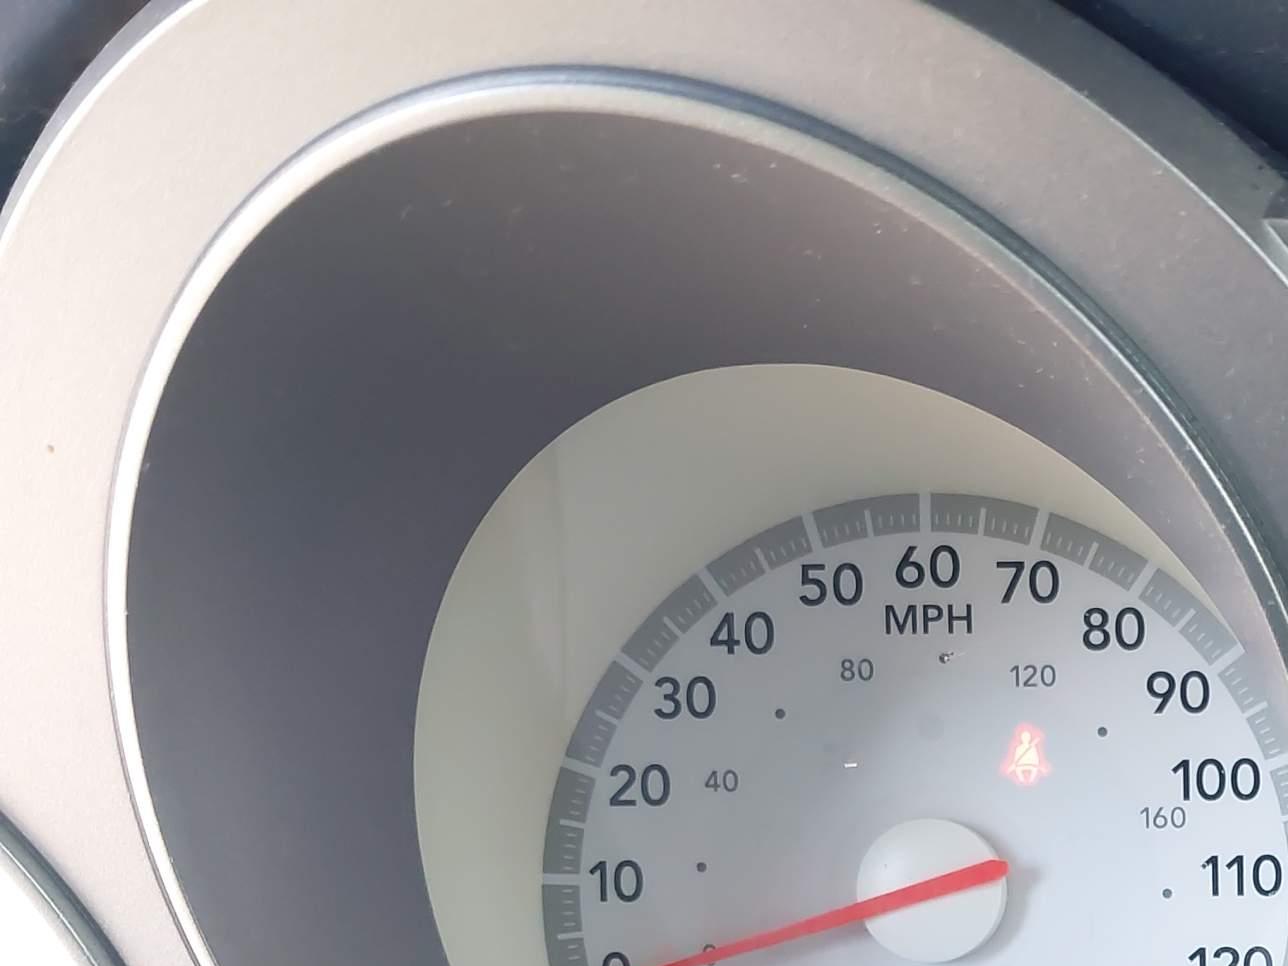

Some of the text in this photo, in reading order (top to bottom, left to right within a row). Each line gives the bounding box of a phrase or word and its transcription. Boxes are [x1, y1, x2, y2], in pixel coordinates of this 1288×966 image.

[800, 562, 864, 606] 50
[895, 544, 961, 589] 60
[996, 560, 1060, 604] 70
[709, 611, 775, 655] 40
[884, 603, 974, 635] MPH
[1082, 606, 1146, 651] 80
[839, 658, 875, 682] 80
[1009, 664, 1057, 689] 120
[653, 675, 718, 720] 30
[1146, 670, 1211, 715] 90
[608, 763, 672, 808] 20
[704, 769, 739, 793] 40
[1170, 757, 1261, 802] 100
[1139, 806, 1187, 830] 160
[588, 859, 644, 903] 10
[1201, 854, 1283, 897] 110
